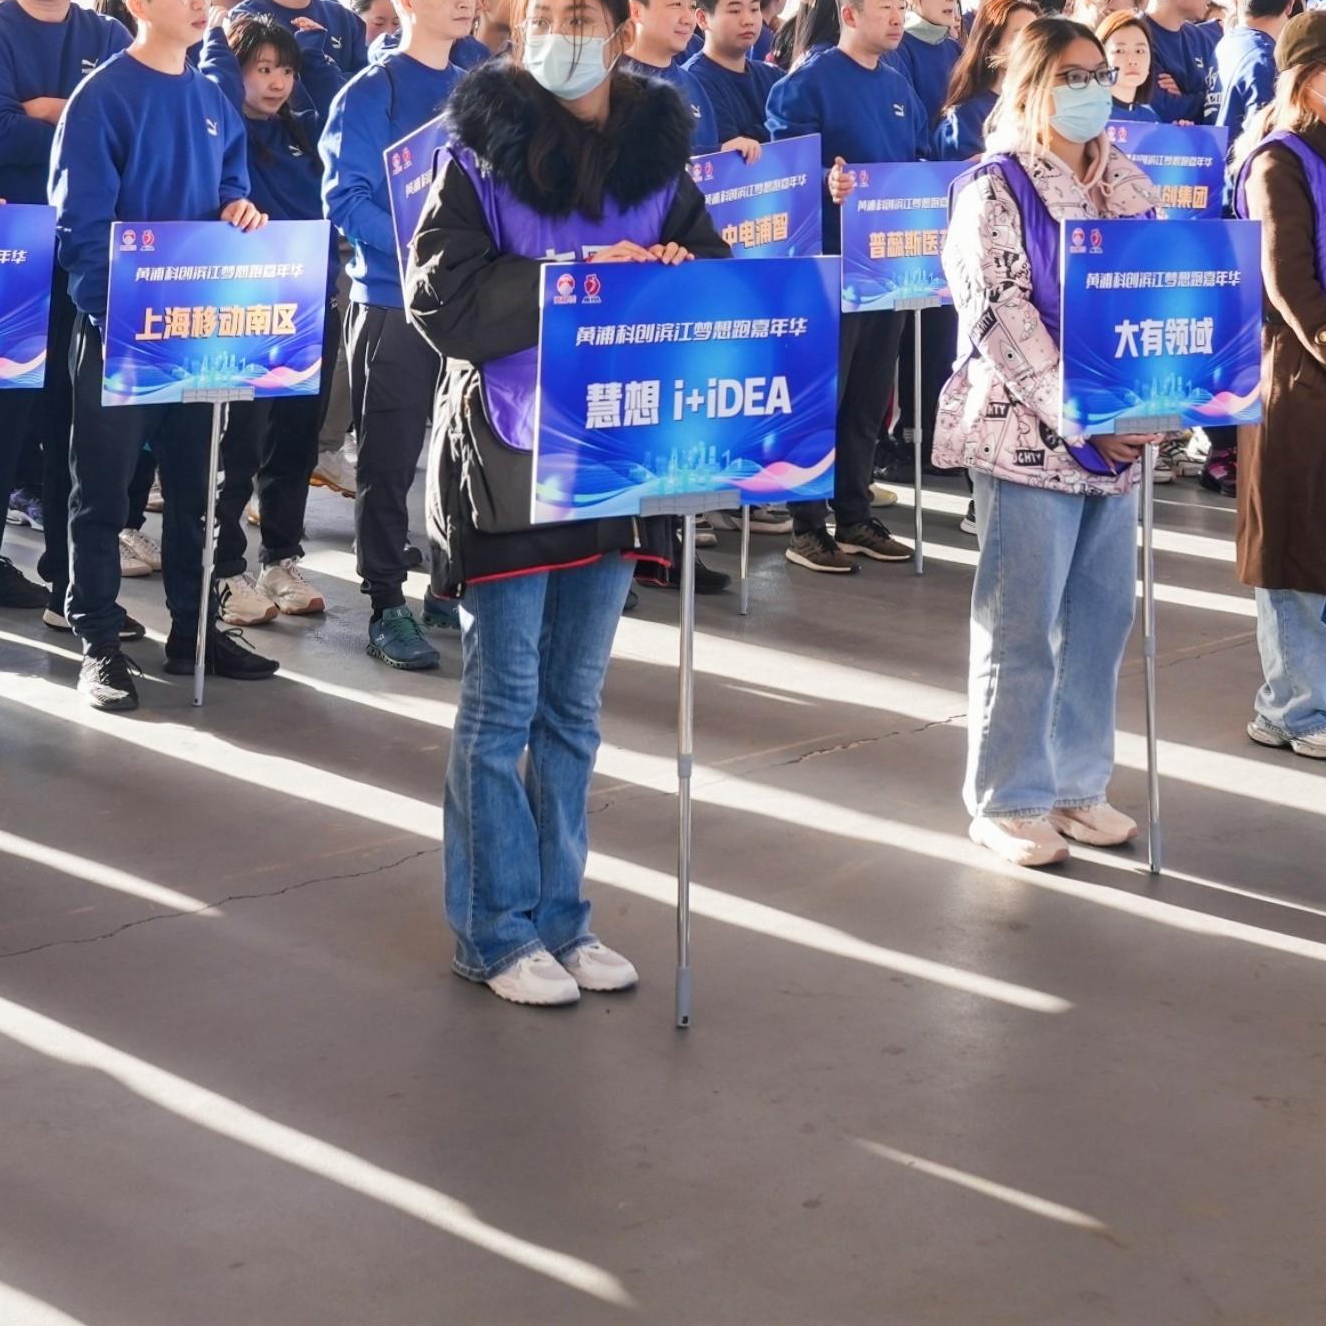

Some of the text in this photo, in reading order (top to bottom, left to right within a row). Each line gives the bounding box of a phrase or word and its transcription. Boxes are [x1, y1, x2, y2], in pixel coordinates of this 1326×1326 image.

[1152, 184, 1209, 210] 创集团
[135, 302, 299, 342] 上海移动南区
[576, 317, 809, 347] 黄浦科创滨江梦想跑嘉年华
[1114, 317, 1214, 358] 大有领域
[585, 376, 792, 431] 慧想 i+iDEA
